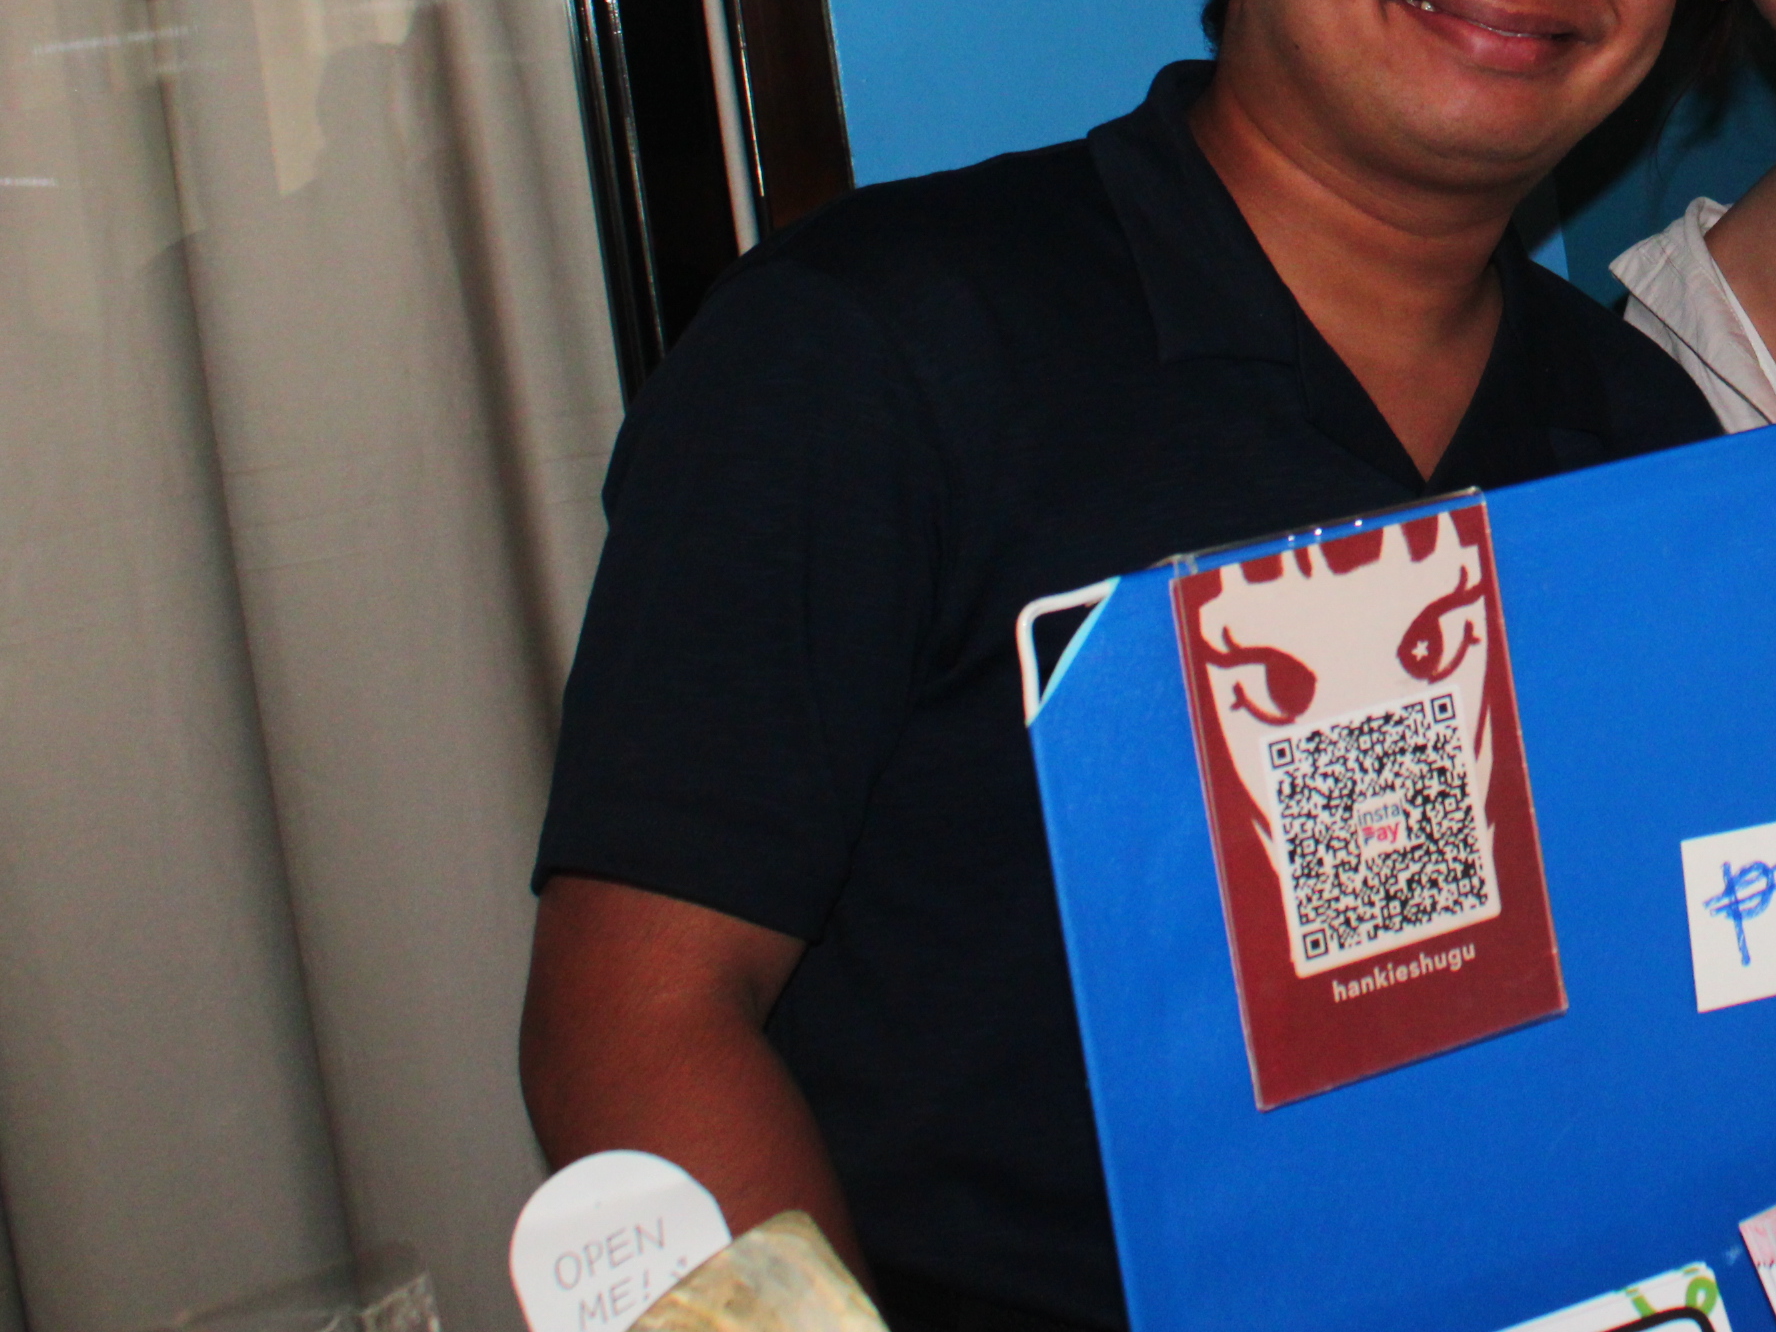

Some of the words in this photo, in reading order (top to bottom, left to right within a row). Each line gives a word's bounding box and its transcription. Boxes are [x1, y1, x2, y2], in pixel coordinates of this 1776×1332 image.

[1331, 942, 1476, 1003] hankieshugu
[554, 1217, 665, 1290] OPEN
[578, 1268, 651, 1332] ME!
